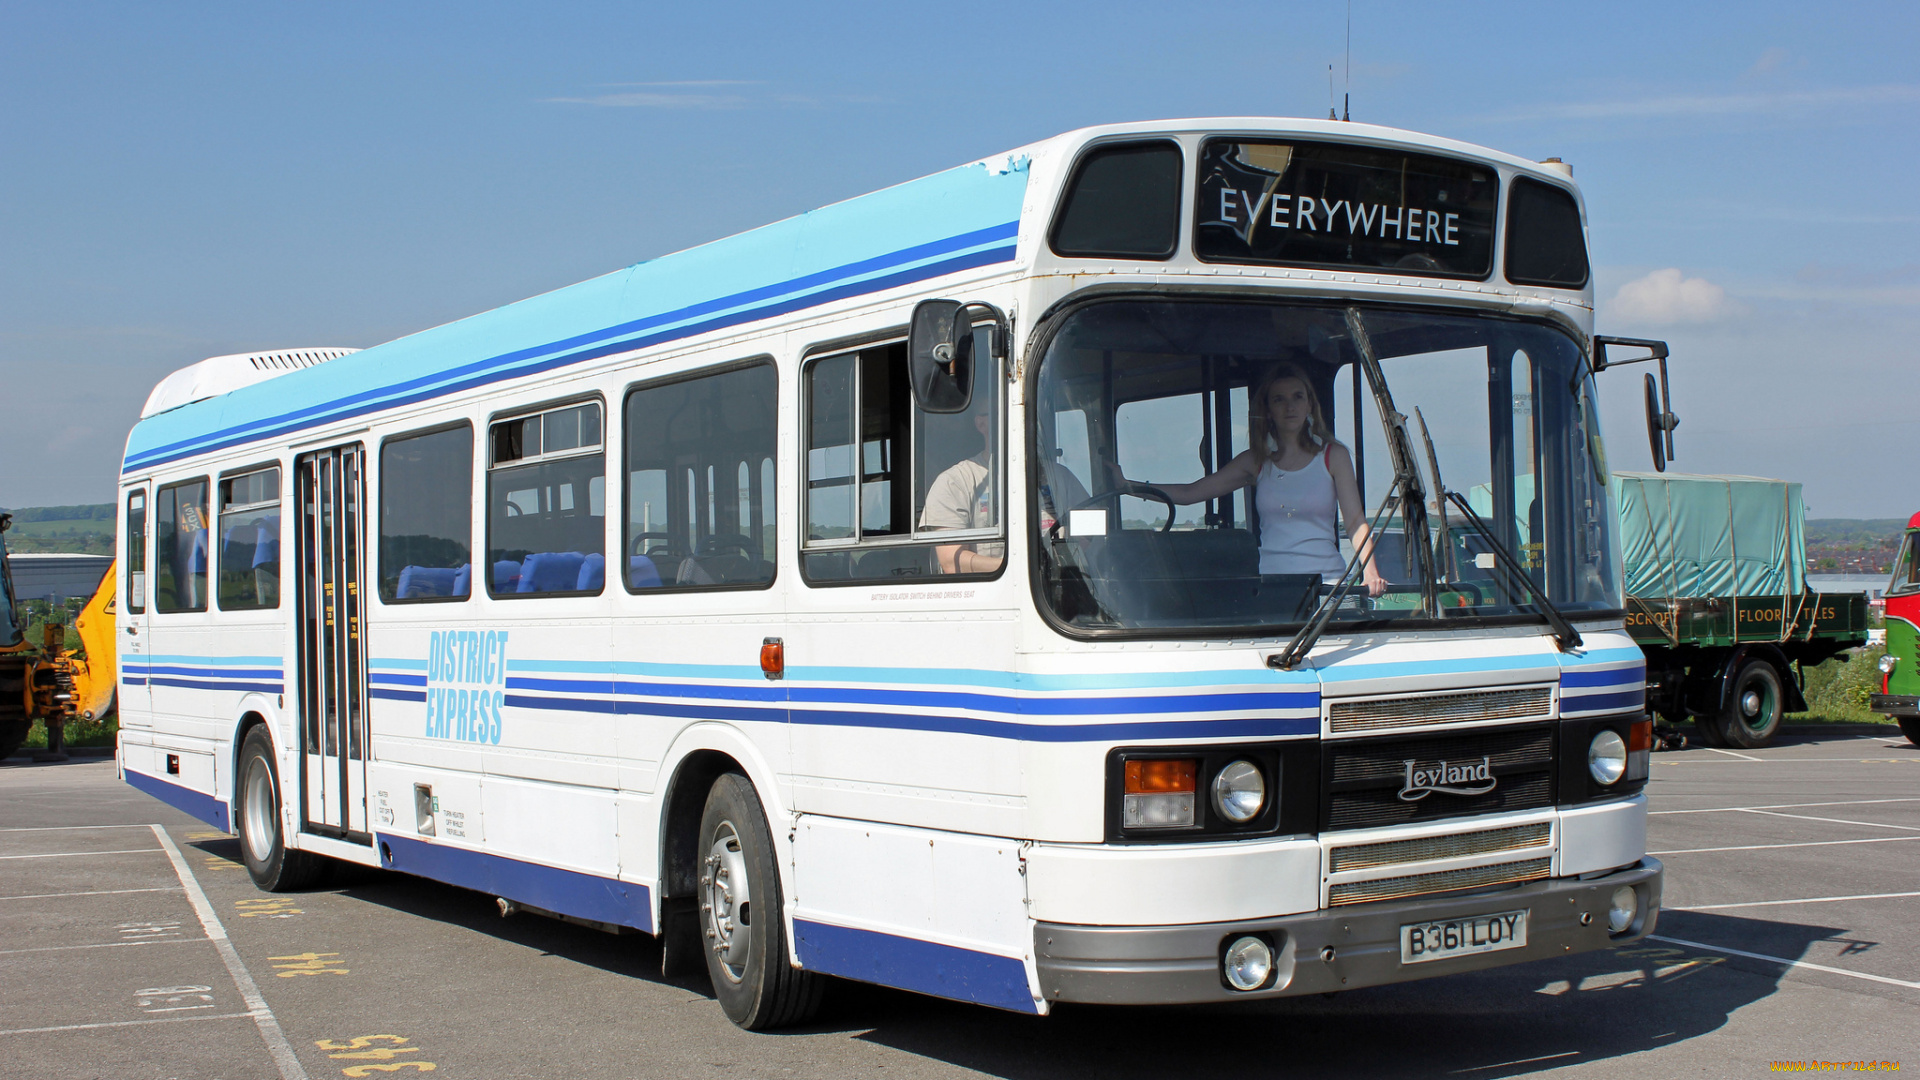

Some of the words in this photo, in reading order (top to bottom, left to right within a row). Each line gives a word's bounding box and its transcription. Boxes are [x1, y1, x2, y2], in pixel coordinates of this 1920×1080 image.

[1220, 187, 1459, 245] EVERYWHERE
[964, 590, 975, 598] SEAT
[1739, 608, 1782, 622] FLOOR
[428, 630, 508, 685] DISTRICT
[425, 688, 504, 745] EXPRESS
[1398, 757, 1496, 800] Leyland
[1410, 922, 1465, 955] B361
[1472, 914, 1518, 946] LOY
